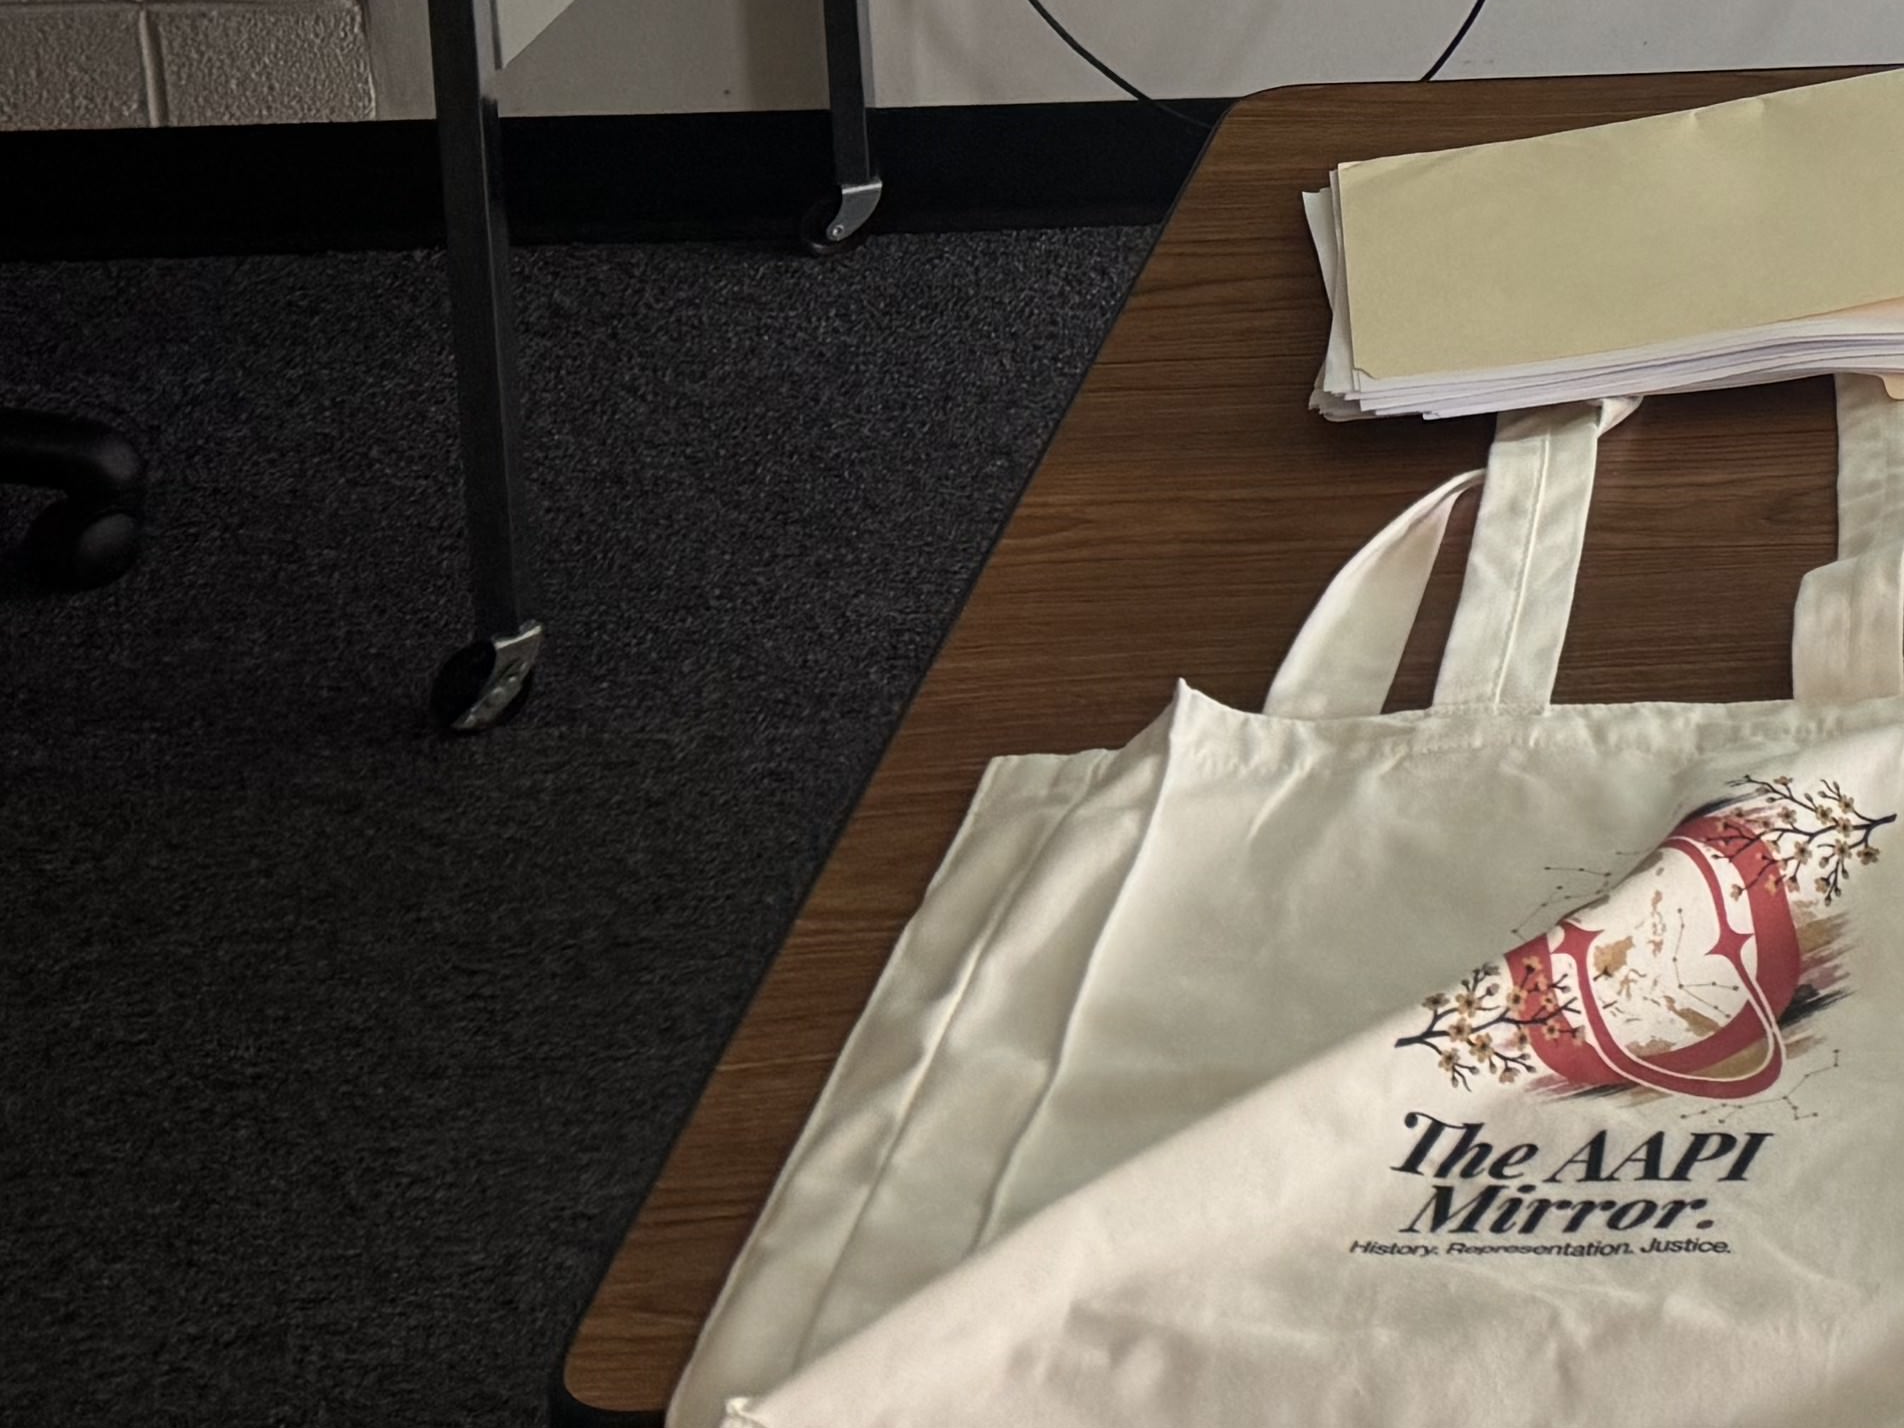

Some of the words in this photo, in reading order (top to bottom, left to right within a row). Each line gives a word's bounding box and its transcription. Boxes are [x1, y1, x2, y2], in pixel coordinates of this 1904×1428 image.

[1391, 1111, 1540, 1180] The
[1543, 1129, 1774, 1185] AAPI
[1399, 1183, 1716, 1235] Mirror.
[1349, 1240, 1439, 1257] History.
[1446, 1241, 1632, 1257] Representation.
[1640, 1238, 1732, 1254] Justice.
